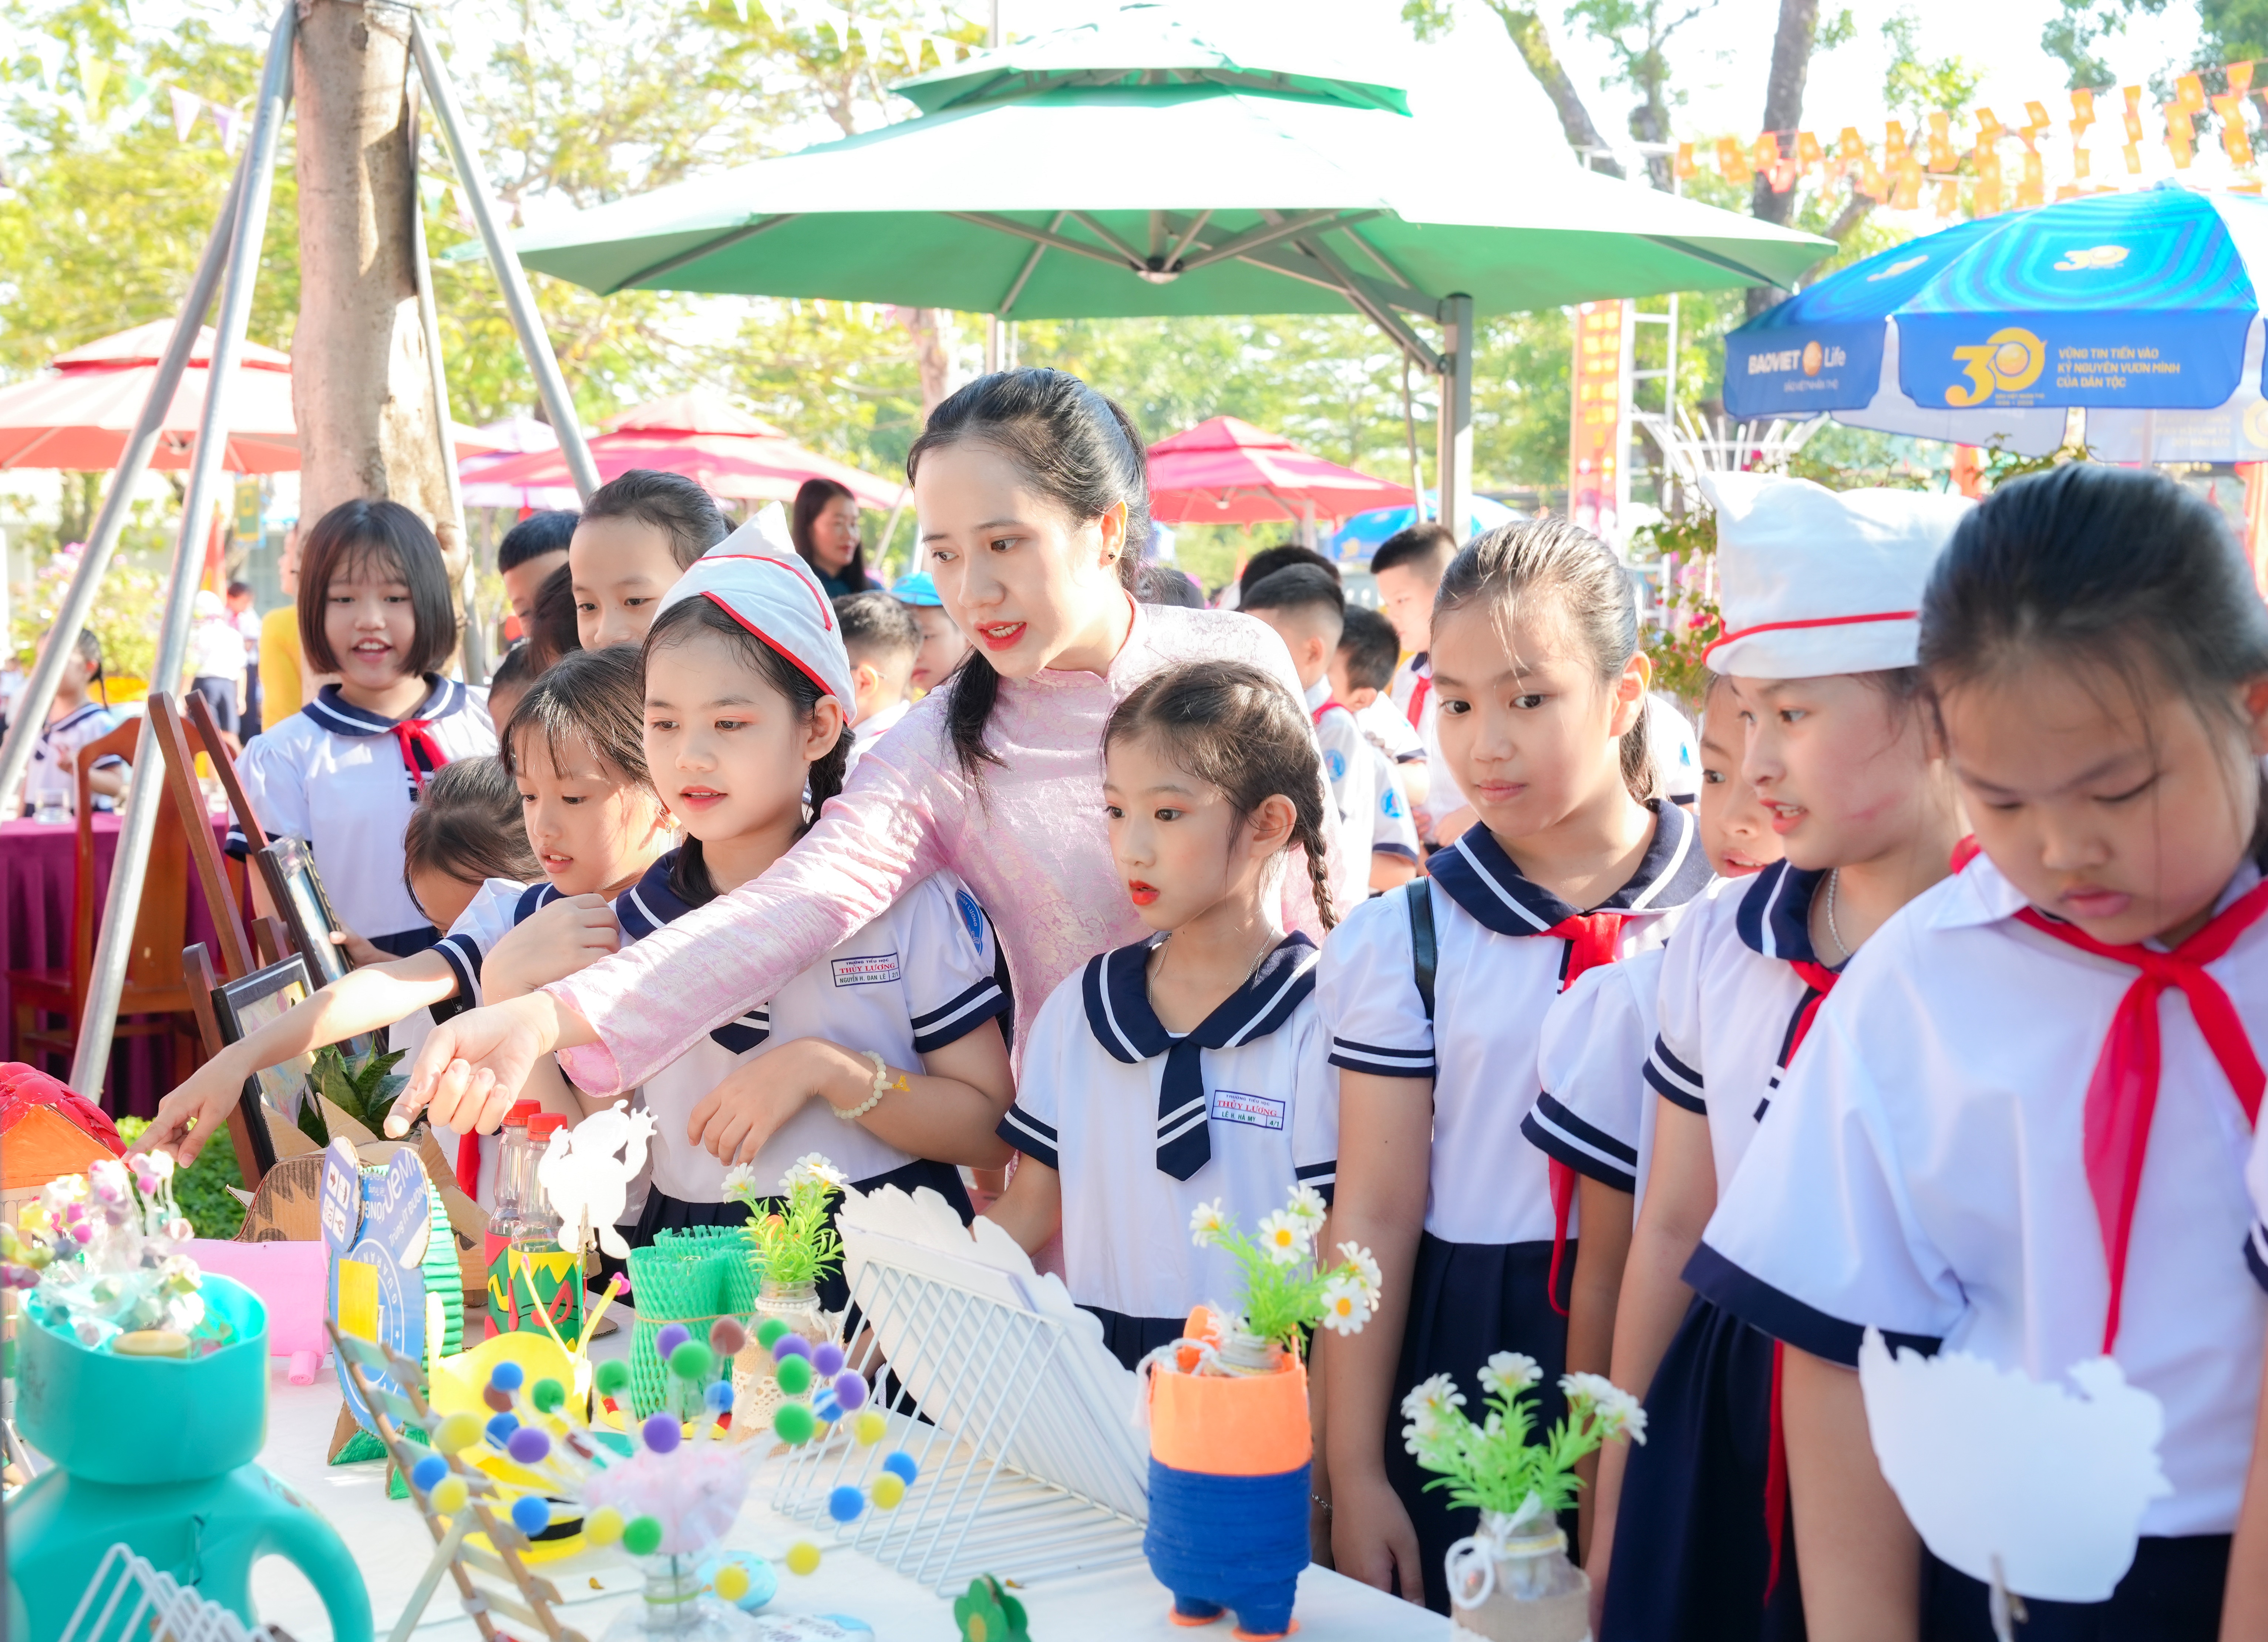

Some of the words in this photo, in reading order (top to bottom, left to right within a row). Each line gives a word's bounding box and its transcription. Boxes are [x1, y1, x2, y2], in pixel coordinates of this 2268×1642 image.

[1824, 346, 1846, 367] Life
[2090, 348, 2108, 358] TIN
[1945, 327, 2047, 407] 30
[839, 965, 862, 973] THỦY
[865, 963, 895, 971] LƯƠNG
[1217, 1100, 1243, 1110] THỦY
[1246, 1105, 1277, 1116] LƯƠNG
